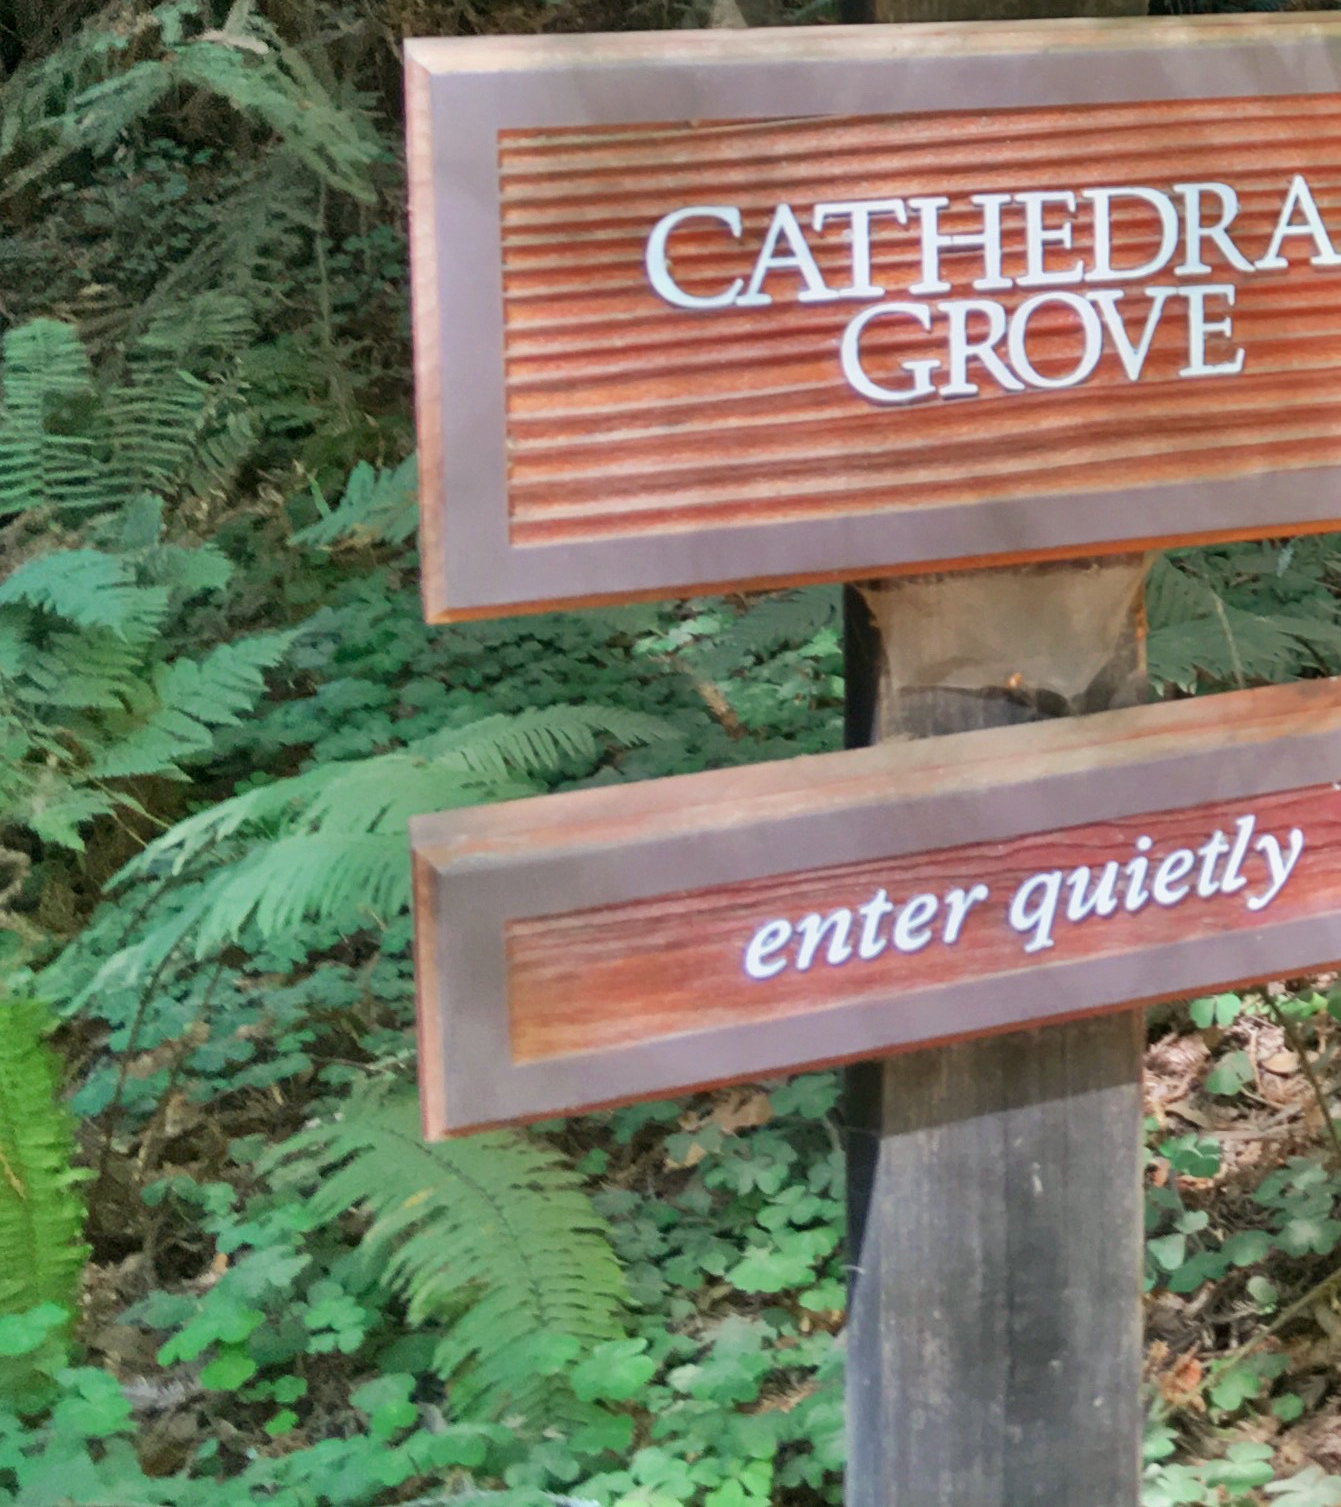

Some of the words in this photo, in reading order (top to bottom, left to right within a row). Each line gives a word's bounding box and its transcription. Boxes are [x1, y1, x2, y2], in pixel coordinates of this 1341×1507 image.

[840, 284, 1246, 403] GROVE
[743, 883, 989, 980] enter
[1008, 814, 1304, 954] quietly
